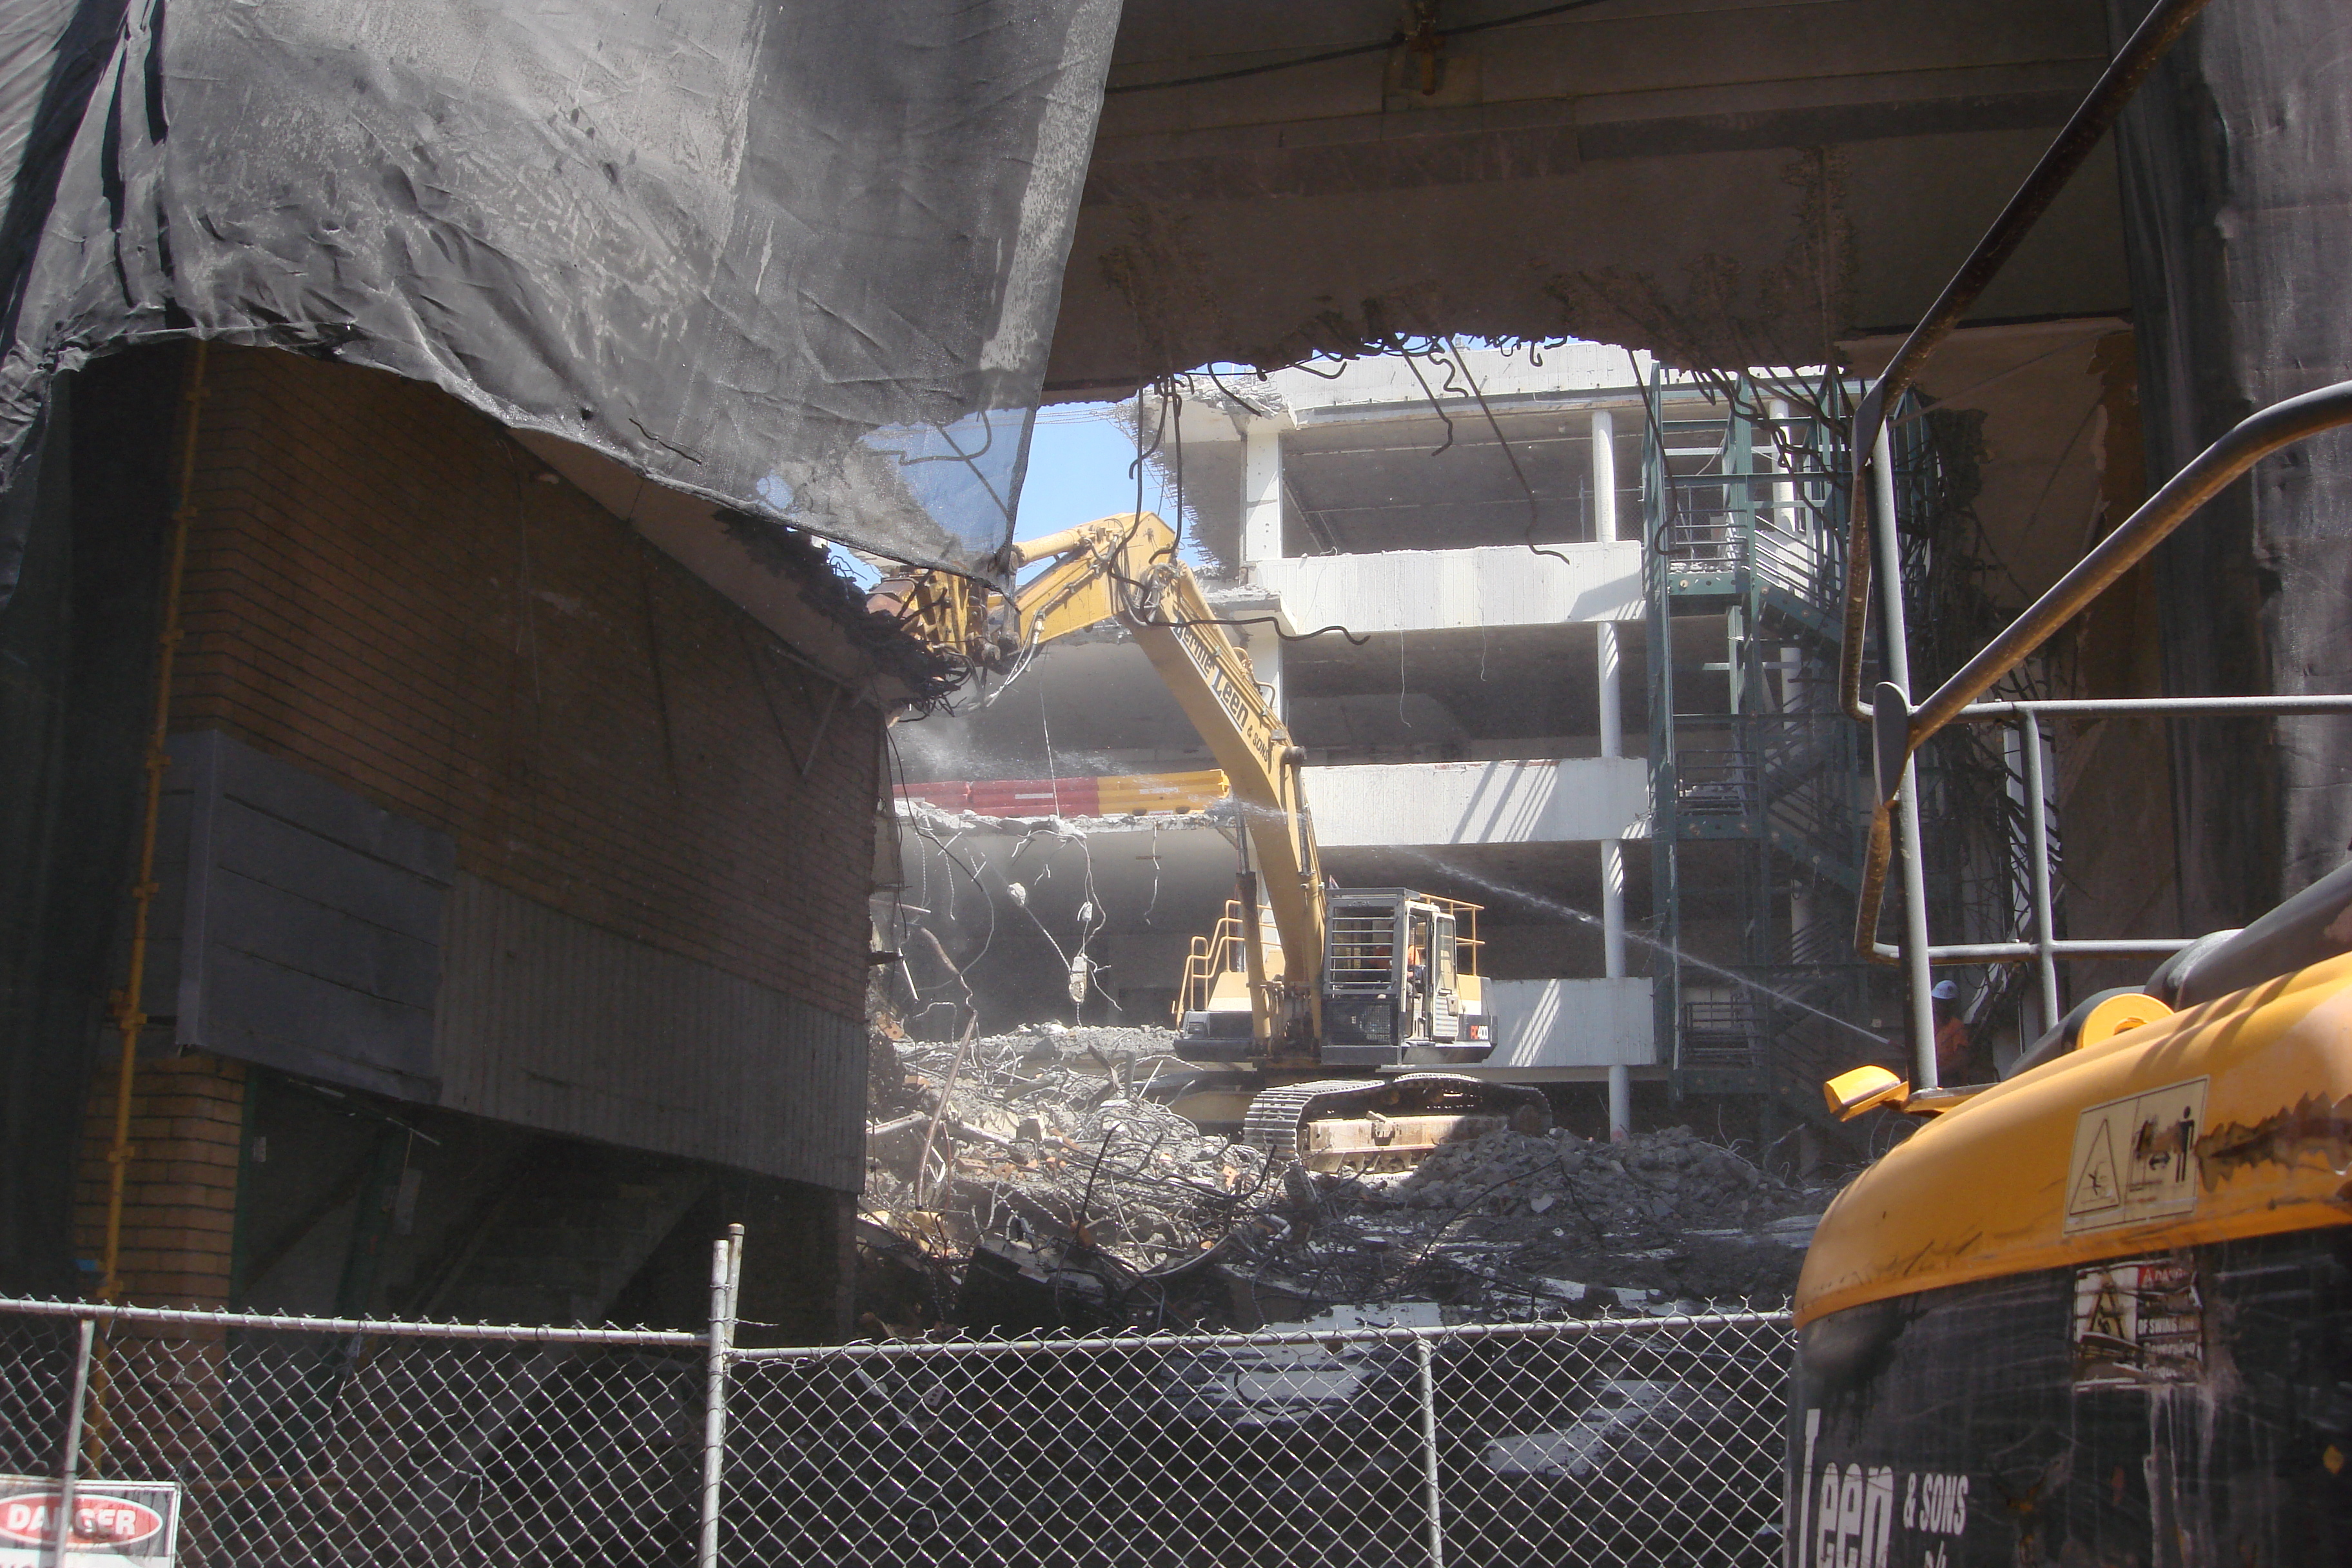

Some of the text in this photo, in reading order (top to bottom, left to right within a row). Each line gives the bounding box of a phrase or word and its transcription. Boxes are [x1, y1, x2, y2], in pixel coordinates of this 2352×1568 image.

[1211, 669, 1248, 728] Leen
[1253, 732, 1269, 762] SONS
[1471, 1025, 1488, 1039] PC400
[6, 1503, 136, 1535] DAGER
[1903, 1473, 1916, 1528] &
[1919, 1473, 1968, 1535] SONS
